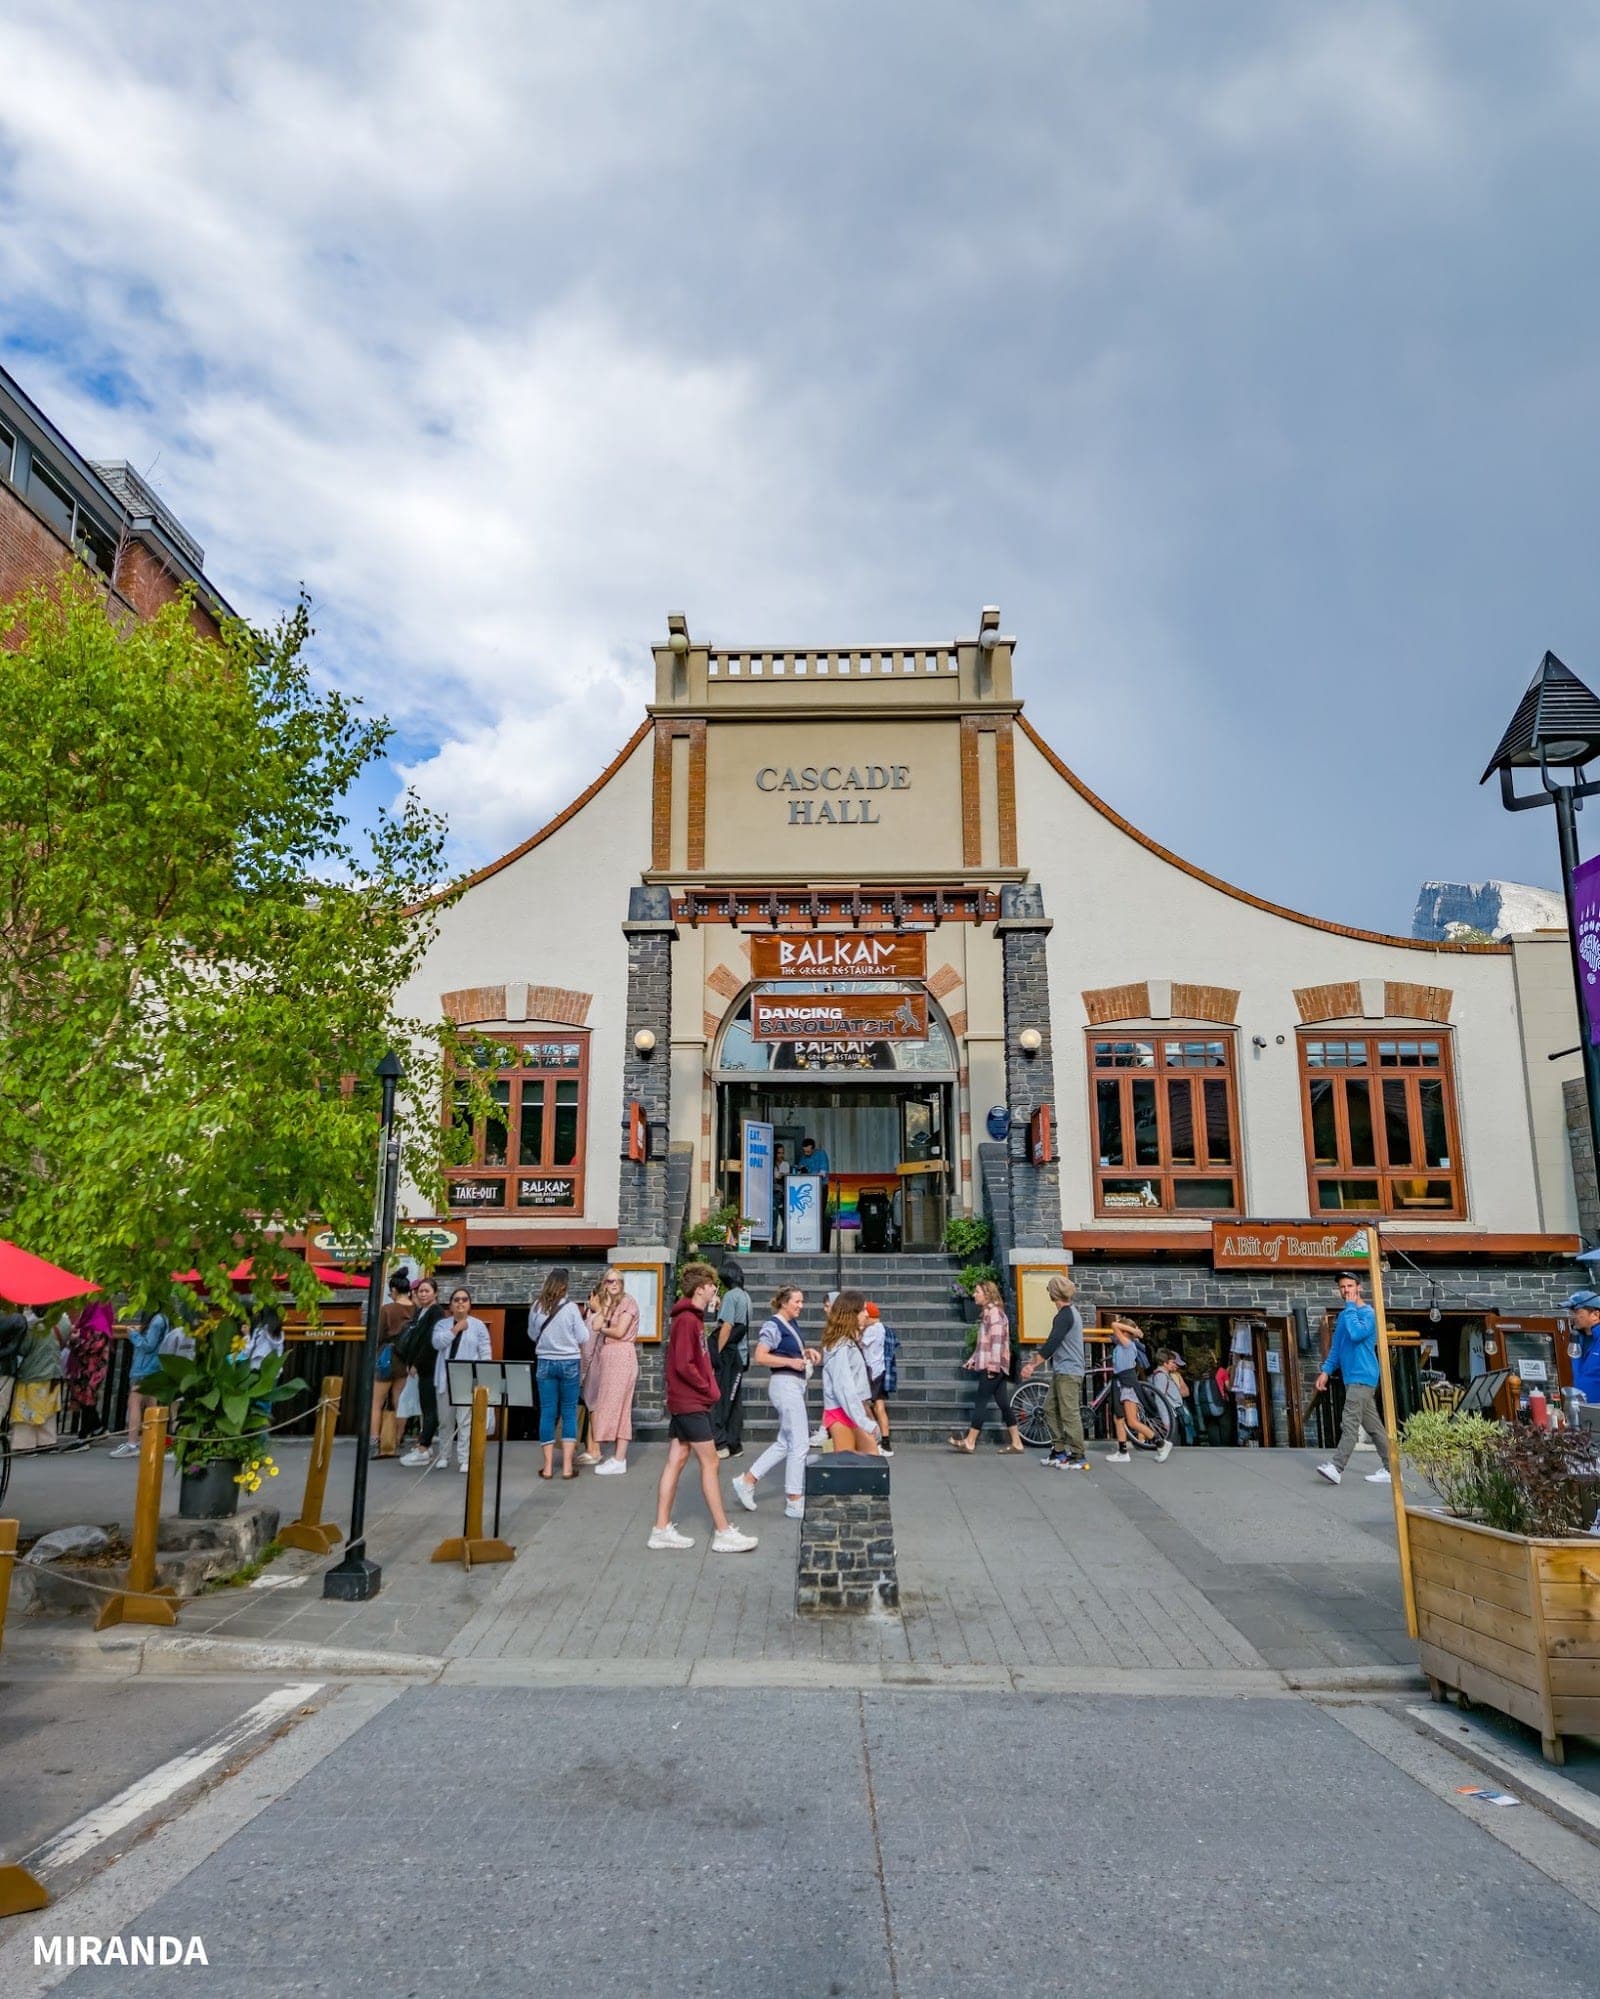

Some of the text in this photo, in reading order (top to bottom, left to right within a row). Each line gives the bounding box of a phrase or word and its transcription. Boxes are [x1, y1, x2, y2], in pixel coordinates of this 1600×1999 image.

[756, 766, 911, 791] CASCADE
[788, 799, 880, 824] HALL
[780, 938, 896, 965] BALKAN
[780, 964, 897, 975] THE GREEK RESTAURANT
[759, 1007, 842, 1019] DANCING
[760, 1019, 896, 1034] SASQUATCH
[455, 1187, 498, 1200] TAKE-OUT
[521, 1181, 570, 1192] BALKAN
[1222, 1237, 1236, 1256] A
[1238, 1236, 1261, 1256] Bit
[1263, 1235, 1285, 1262] of
